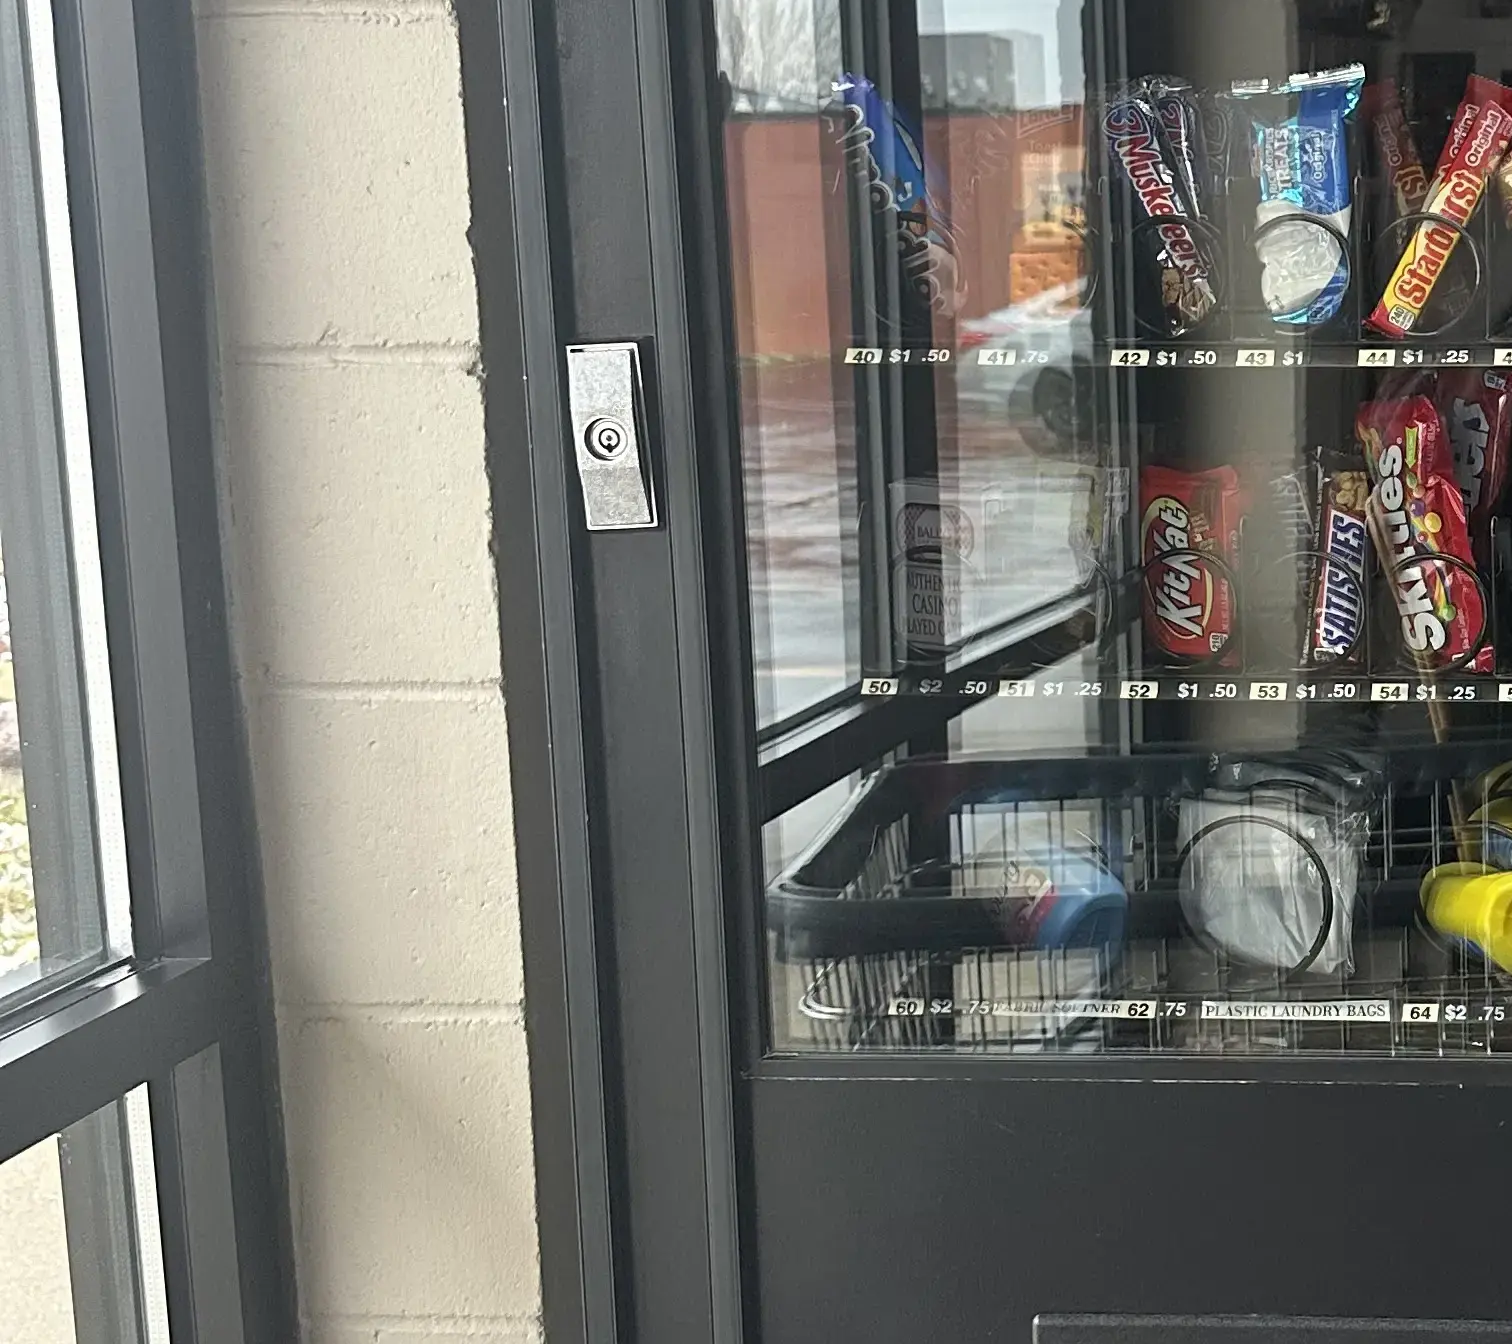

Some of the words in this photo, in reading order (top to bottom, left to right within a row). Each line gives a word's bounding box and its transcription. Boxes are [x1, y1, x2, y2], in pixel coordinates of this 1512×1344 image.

[1105, 108, 1144, 134] 3
[1464, 109, 1501, 167] Original
[1274, 127, 1292, 190] TREATS
[1390, 307, 1404, 325] 240
[852, 350, 876, 365] 40
[889, 348, 911, 364] $1
[921, 348, 950, 363] .50
[1119, 350, 1142, 365] 42
[1155, 350, 1178, 366] $1
[1187, 350, 1218, 365] .50
[1282, 350, 1305, 366] $1
[1402, 349, 1424, 365] $1
[1440, 349, 1469, 364] .25
[912, 593, 959, 616] CASINO
[868, 679, 892, 694] 50
[958, 679, 988, 694] .50
[1127, 683, 1151, 698] 52
[1177, 682, 1199, 699] $1
[1208, 683, 1238, 699] .50
[1256, 684, 1280, 699] 53
[1295, 682, 1317, 699] $1
[1327, 683, 1356, 698] .50
[1378, 685, 1402, 700] 54
[1416, 683, 1437, 700] $1
[1446, 684, 1476, 700] .25
[1127, 1002, 1150, 1018] 62
[1159, 1001, 1187, 1017] .75
[1270, 1003, 1342, 1020] LAUNDRY
[1345, 1003, 1386, 1019] BAGS
[1409, 1005, 1433, 1021] 64
[1444, 1003, 1467, 1022] $2
[1476, 1004, 1505, 1021] .75
